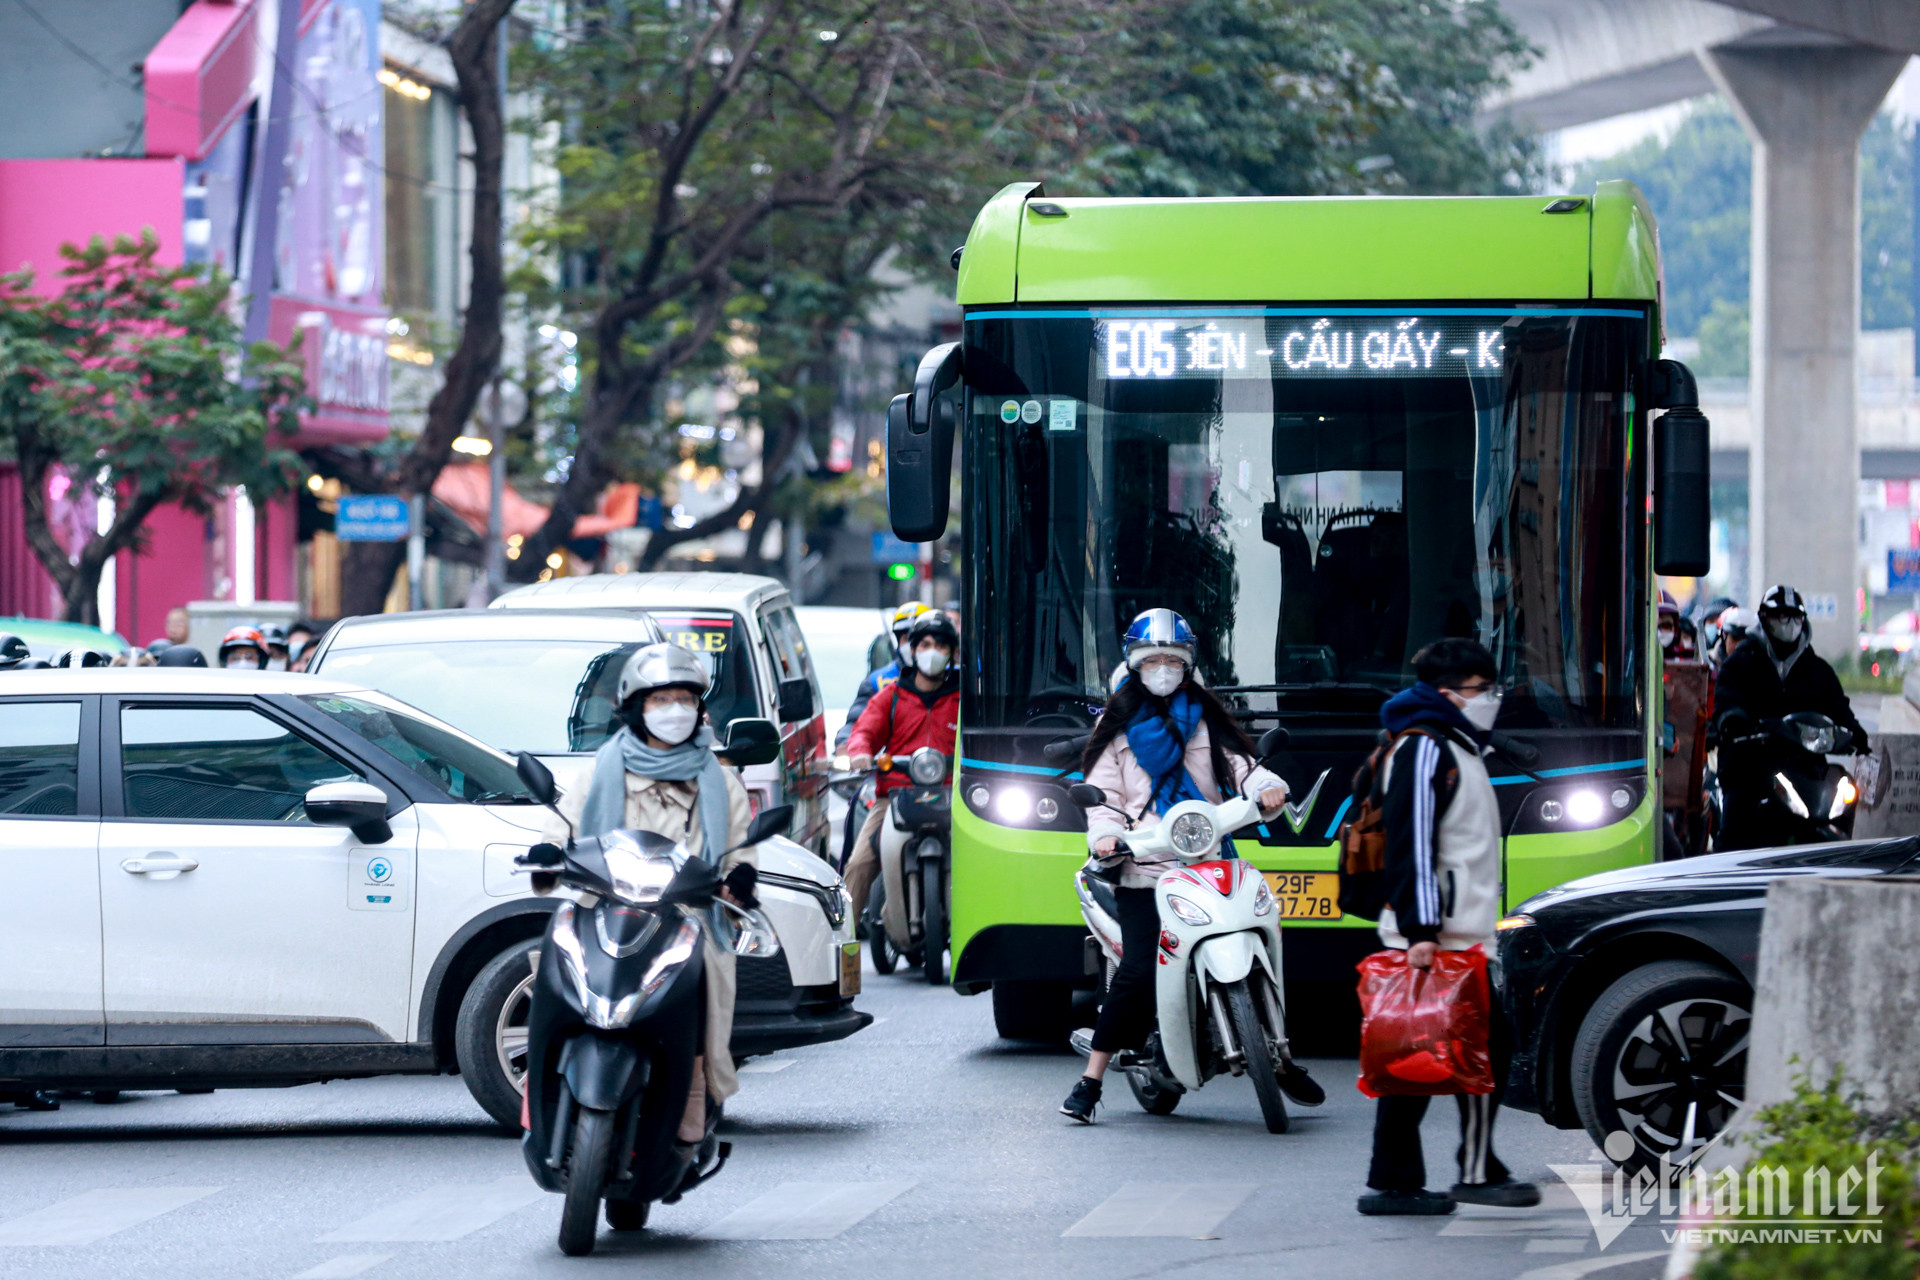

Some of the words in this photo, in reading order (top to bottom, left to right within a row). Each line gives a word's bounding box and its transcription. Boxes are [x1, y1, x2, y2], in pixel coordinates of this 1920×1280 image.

[1107, 321, 1176, 377] E05
[1283, 317, 1353, 369] CẦU
[1362, 317, 1441, 369] GIẤY
[1477, 330, 1506, 368] K
[1276, 875, 1316, 894] 29F
[1274, 896, 1332, 916] 07.78
